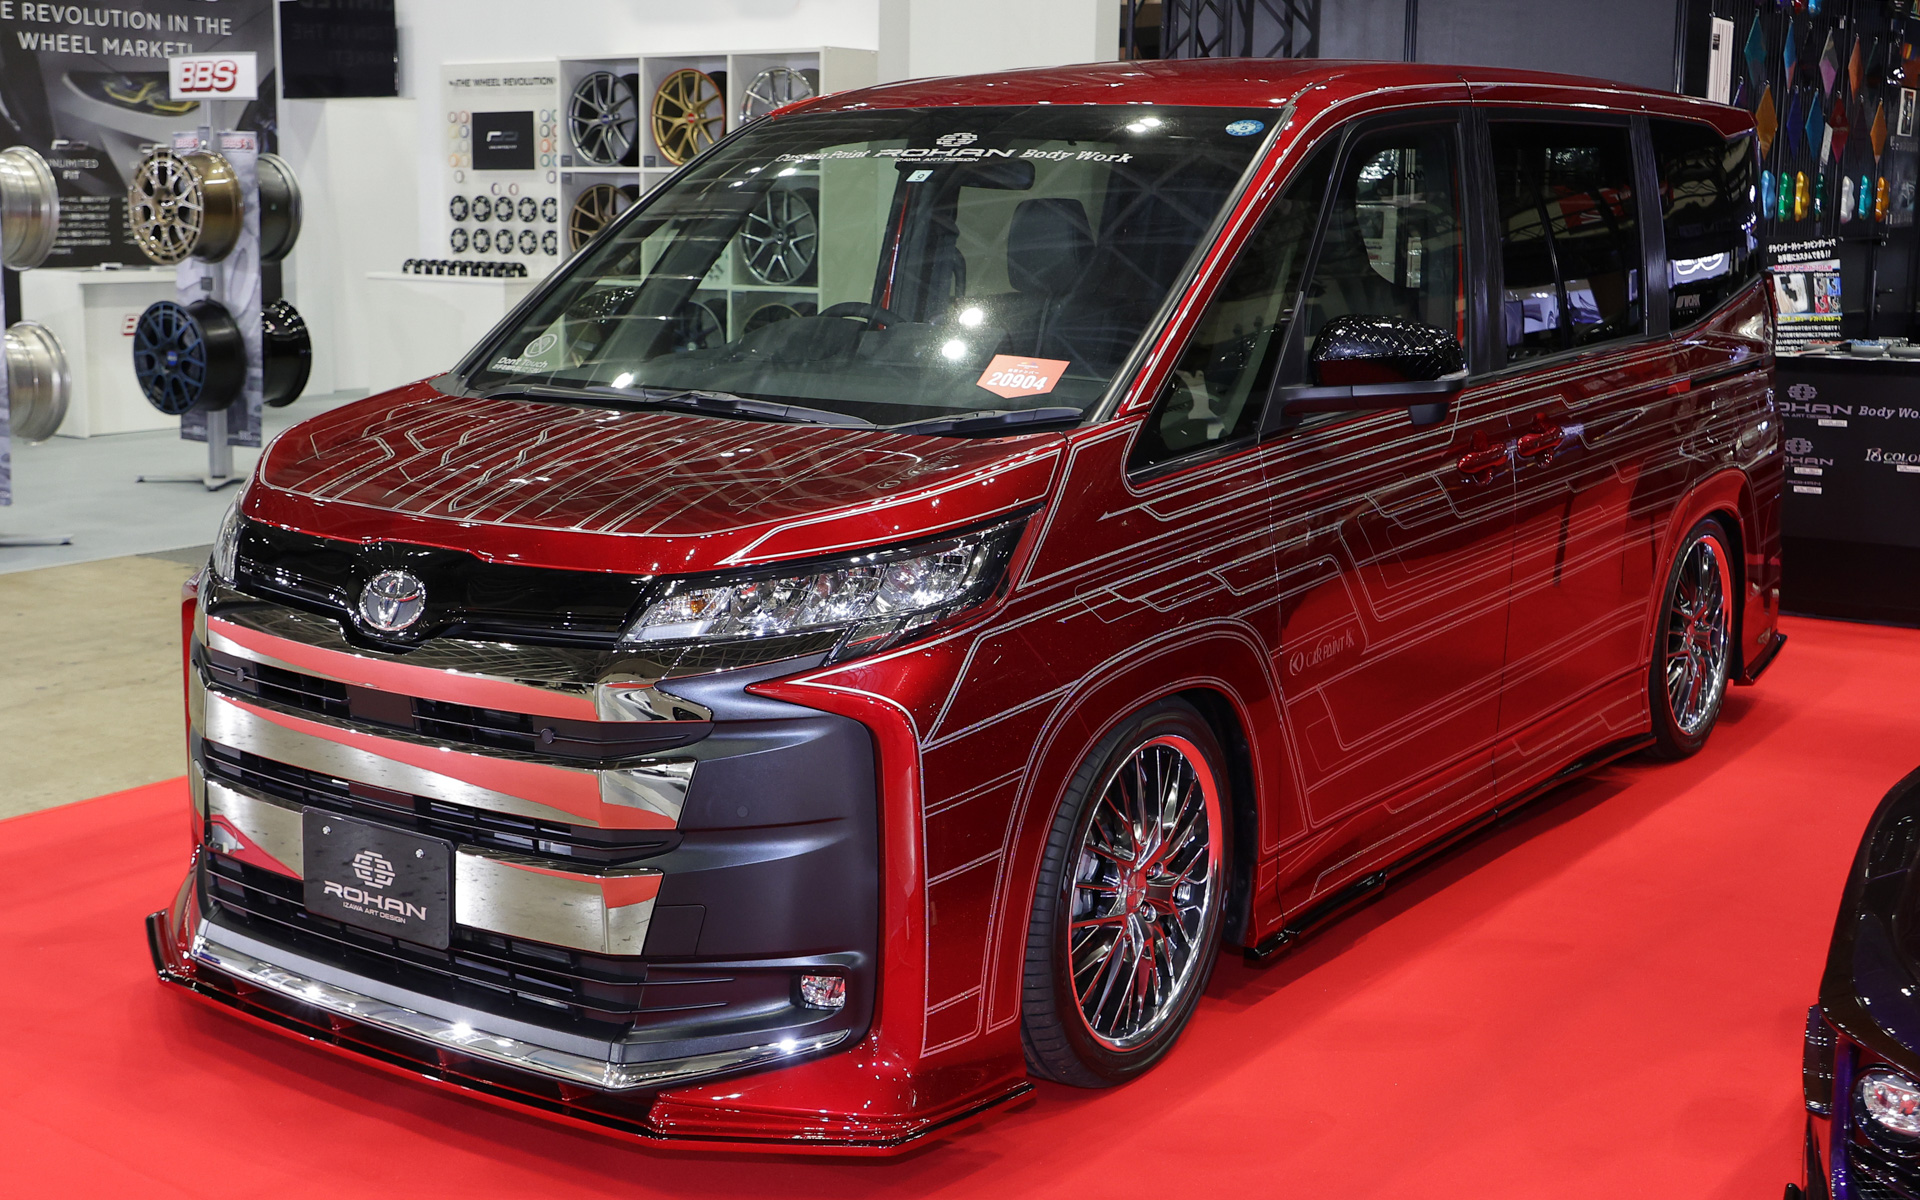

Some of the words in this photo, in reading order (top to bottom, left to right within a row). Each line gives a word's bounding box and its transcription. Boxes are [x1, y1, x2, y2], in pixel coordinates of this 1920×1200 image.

[21, 2, 161, 31] REVOLUTION
[167, 14, 189, 33] IN
[193, 15, 232, 36] THE
[16, 31, 97, 55] WHEEL
[180, 60, 238, 92] BBS
[827, 149, 872, 160] Paint
[872, 148, 1017, 158] ROHAN
[1019, 149, 1075, 162] Body
[1075, 150, 1134, 163] Work
[986, 371, 1048, 391] 20904
[1779, 402, 1852, 415] OHAN
[1858, 405, 1895, 419] Body
[1898, 407, 1920, 419] Wo
[1783, 456, 1834, 466] OHAN
[323, 880, 427, 921] ROHAN
[342, 901, 364, 913] IZAWA
[364, 907, 379, 916] ART
[379, 911, 406, 924] DESIGN
